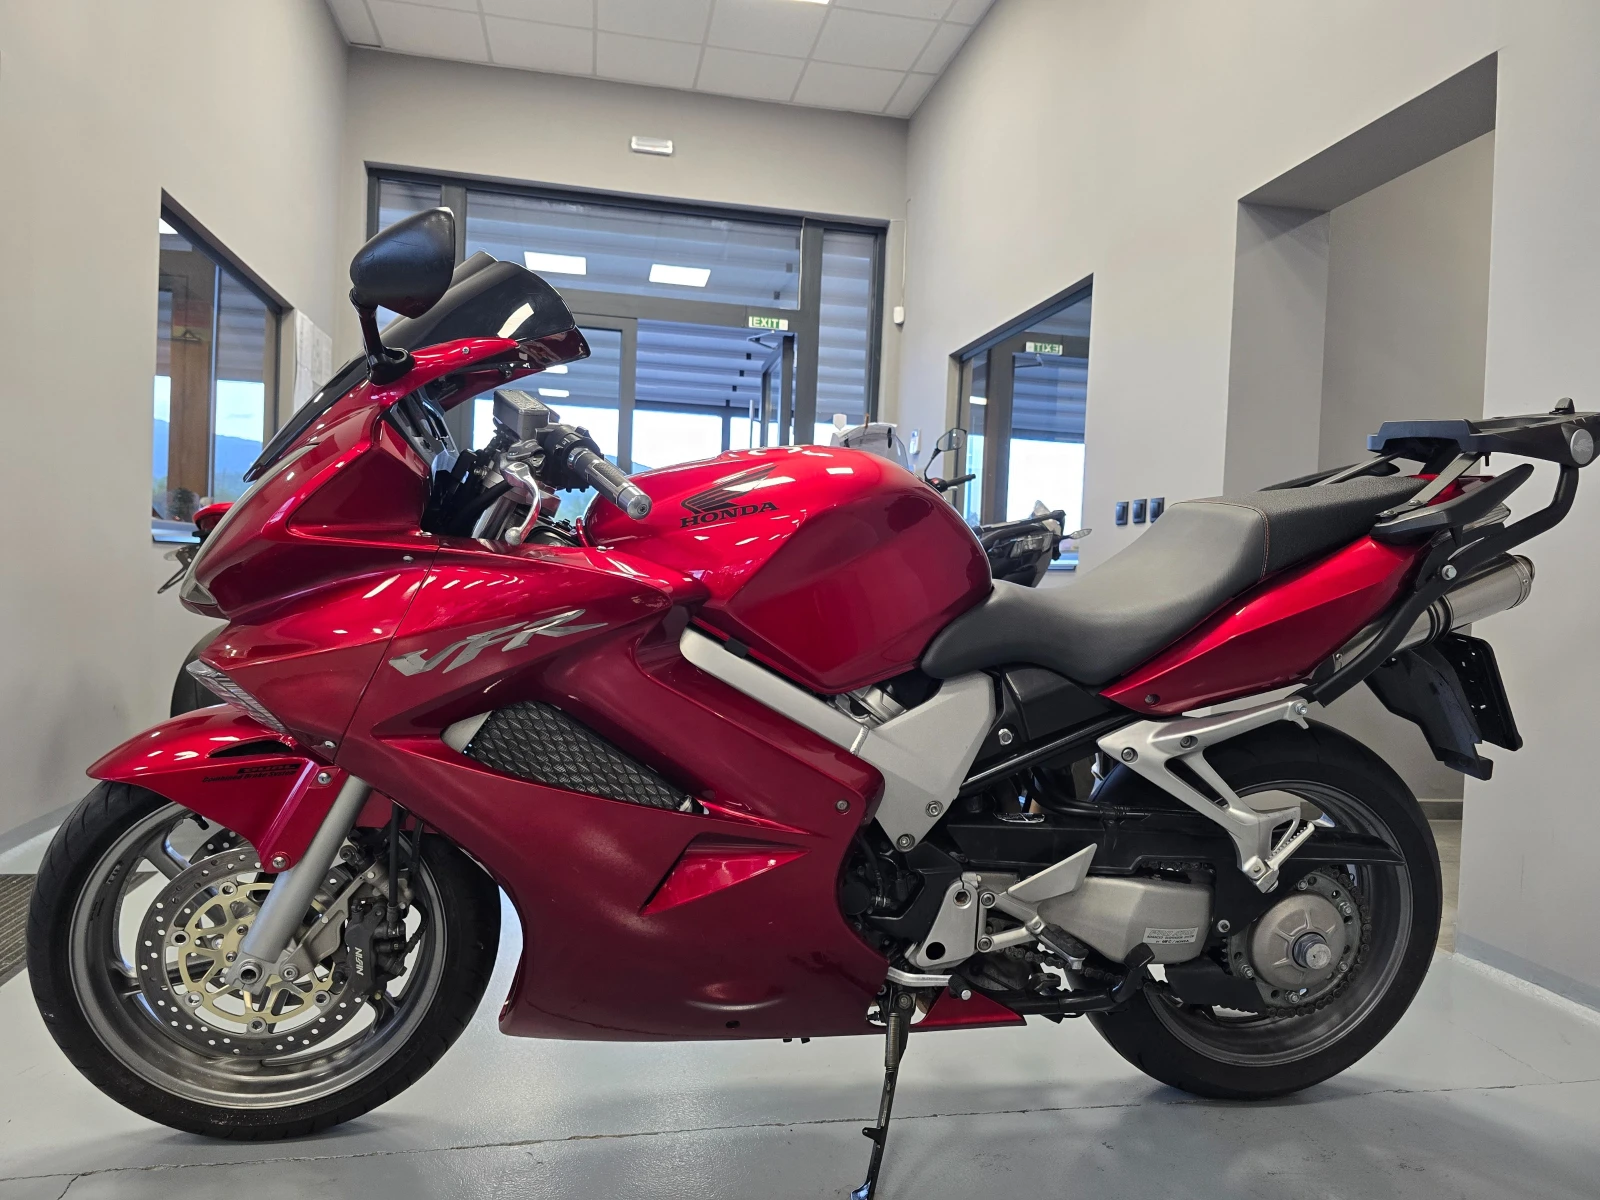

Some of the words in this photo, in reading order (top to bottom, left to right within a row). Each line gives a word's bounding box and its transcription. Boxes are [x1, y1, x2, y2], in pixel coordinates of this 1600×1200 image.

[753, 316, 779, 329] EXIT
[680, 502, 779, 528] HONDA
[389, 608, 609, 677] VFR
[354, 946, 364, 976] NISSIN
